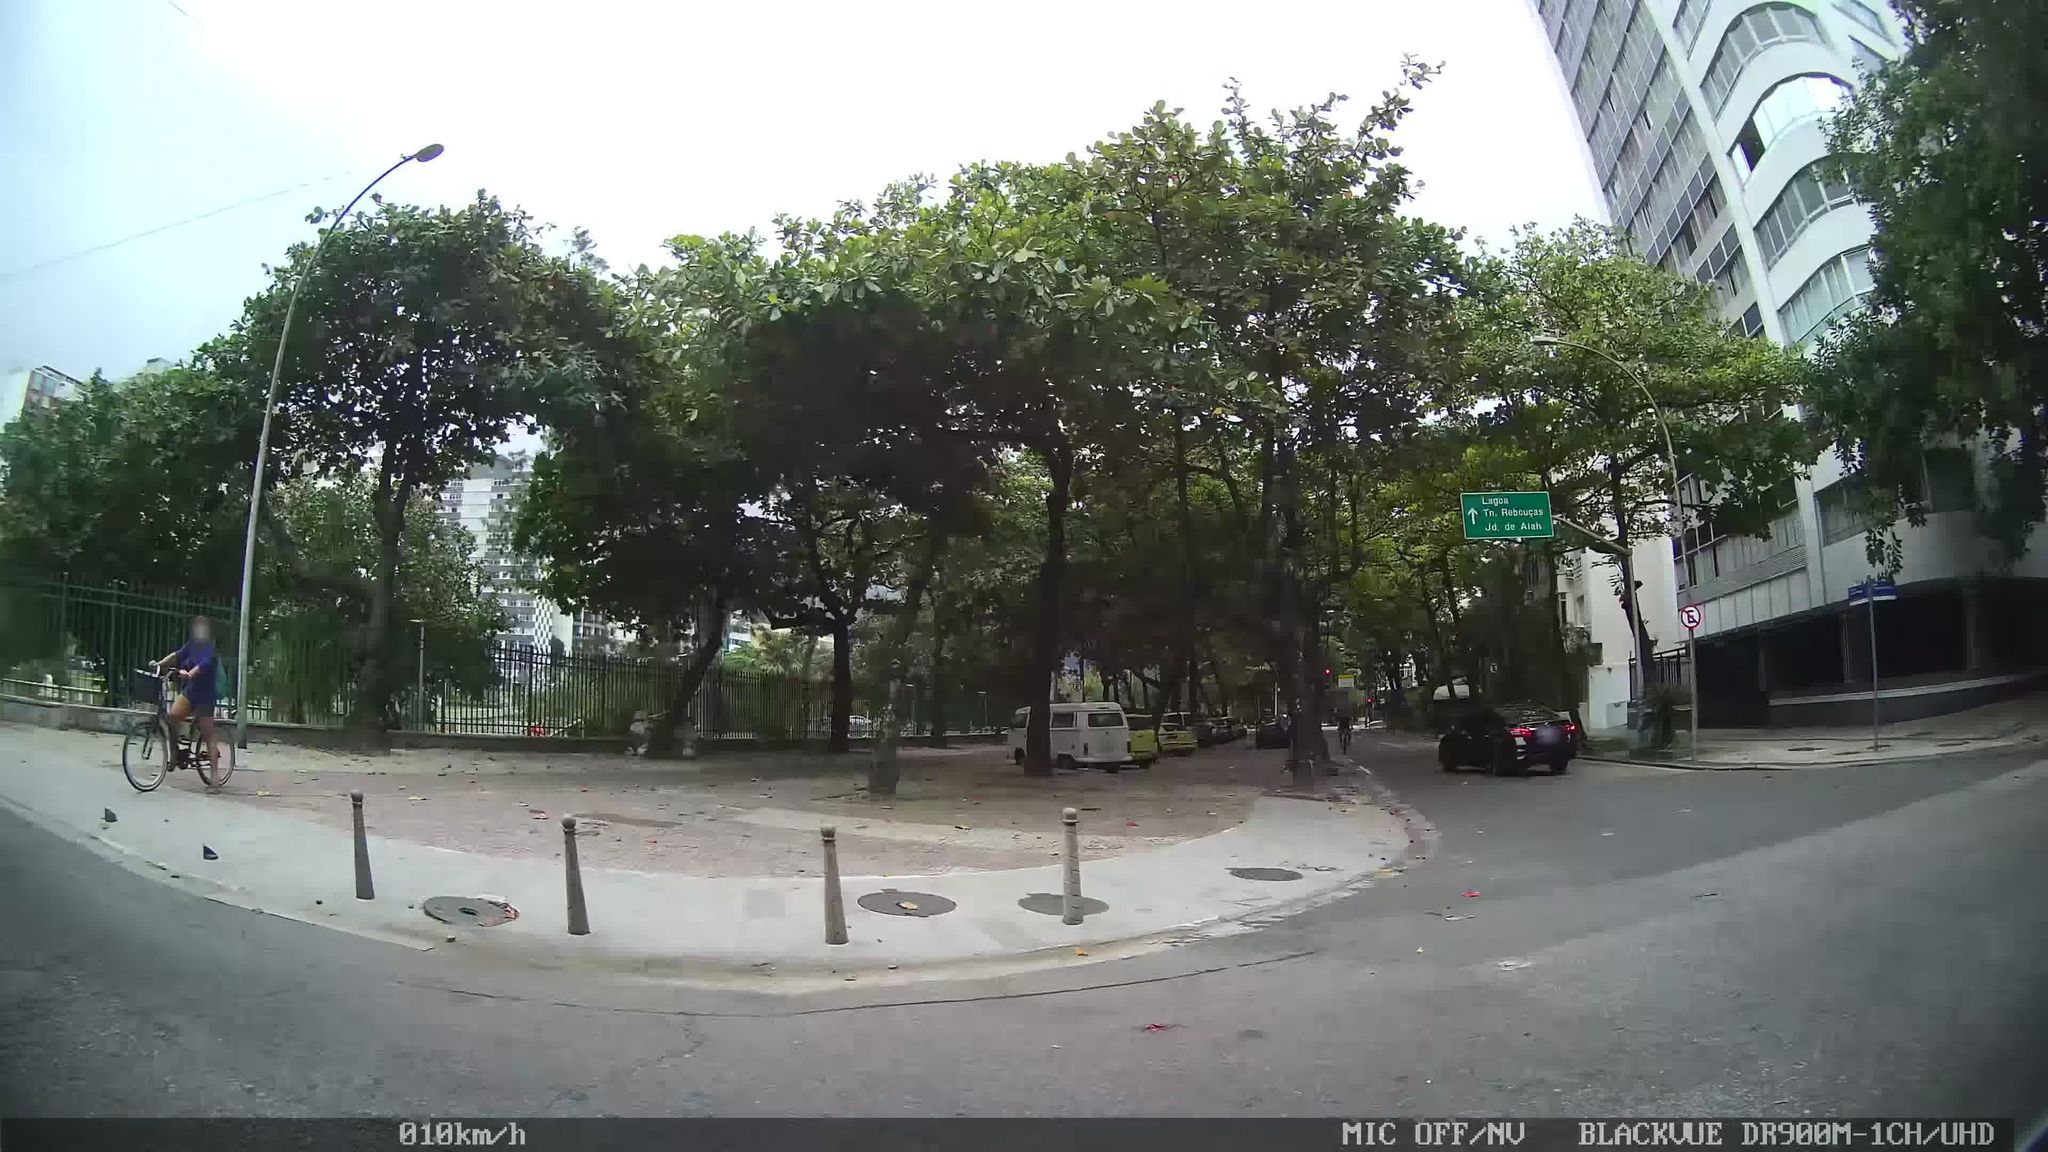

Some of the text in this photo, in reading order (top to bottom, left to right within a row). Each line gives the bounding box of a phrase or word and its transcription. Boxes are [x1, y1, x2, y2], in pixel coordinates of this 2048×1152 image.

[1481, 496, 1509, 506] Lagoa
[1483, 508, 1544, 517] Tn. Rebouças
[1485, 522, 1500, 531] Jd.
[1504, 522, 1515, 530] de
